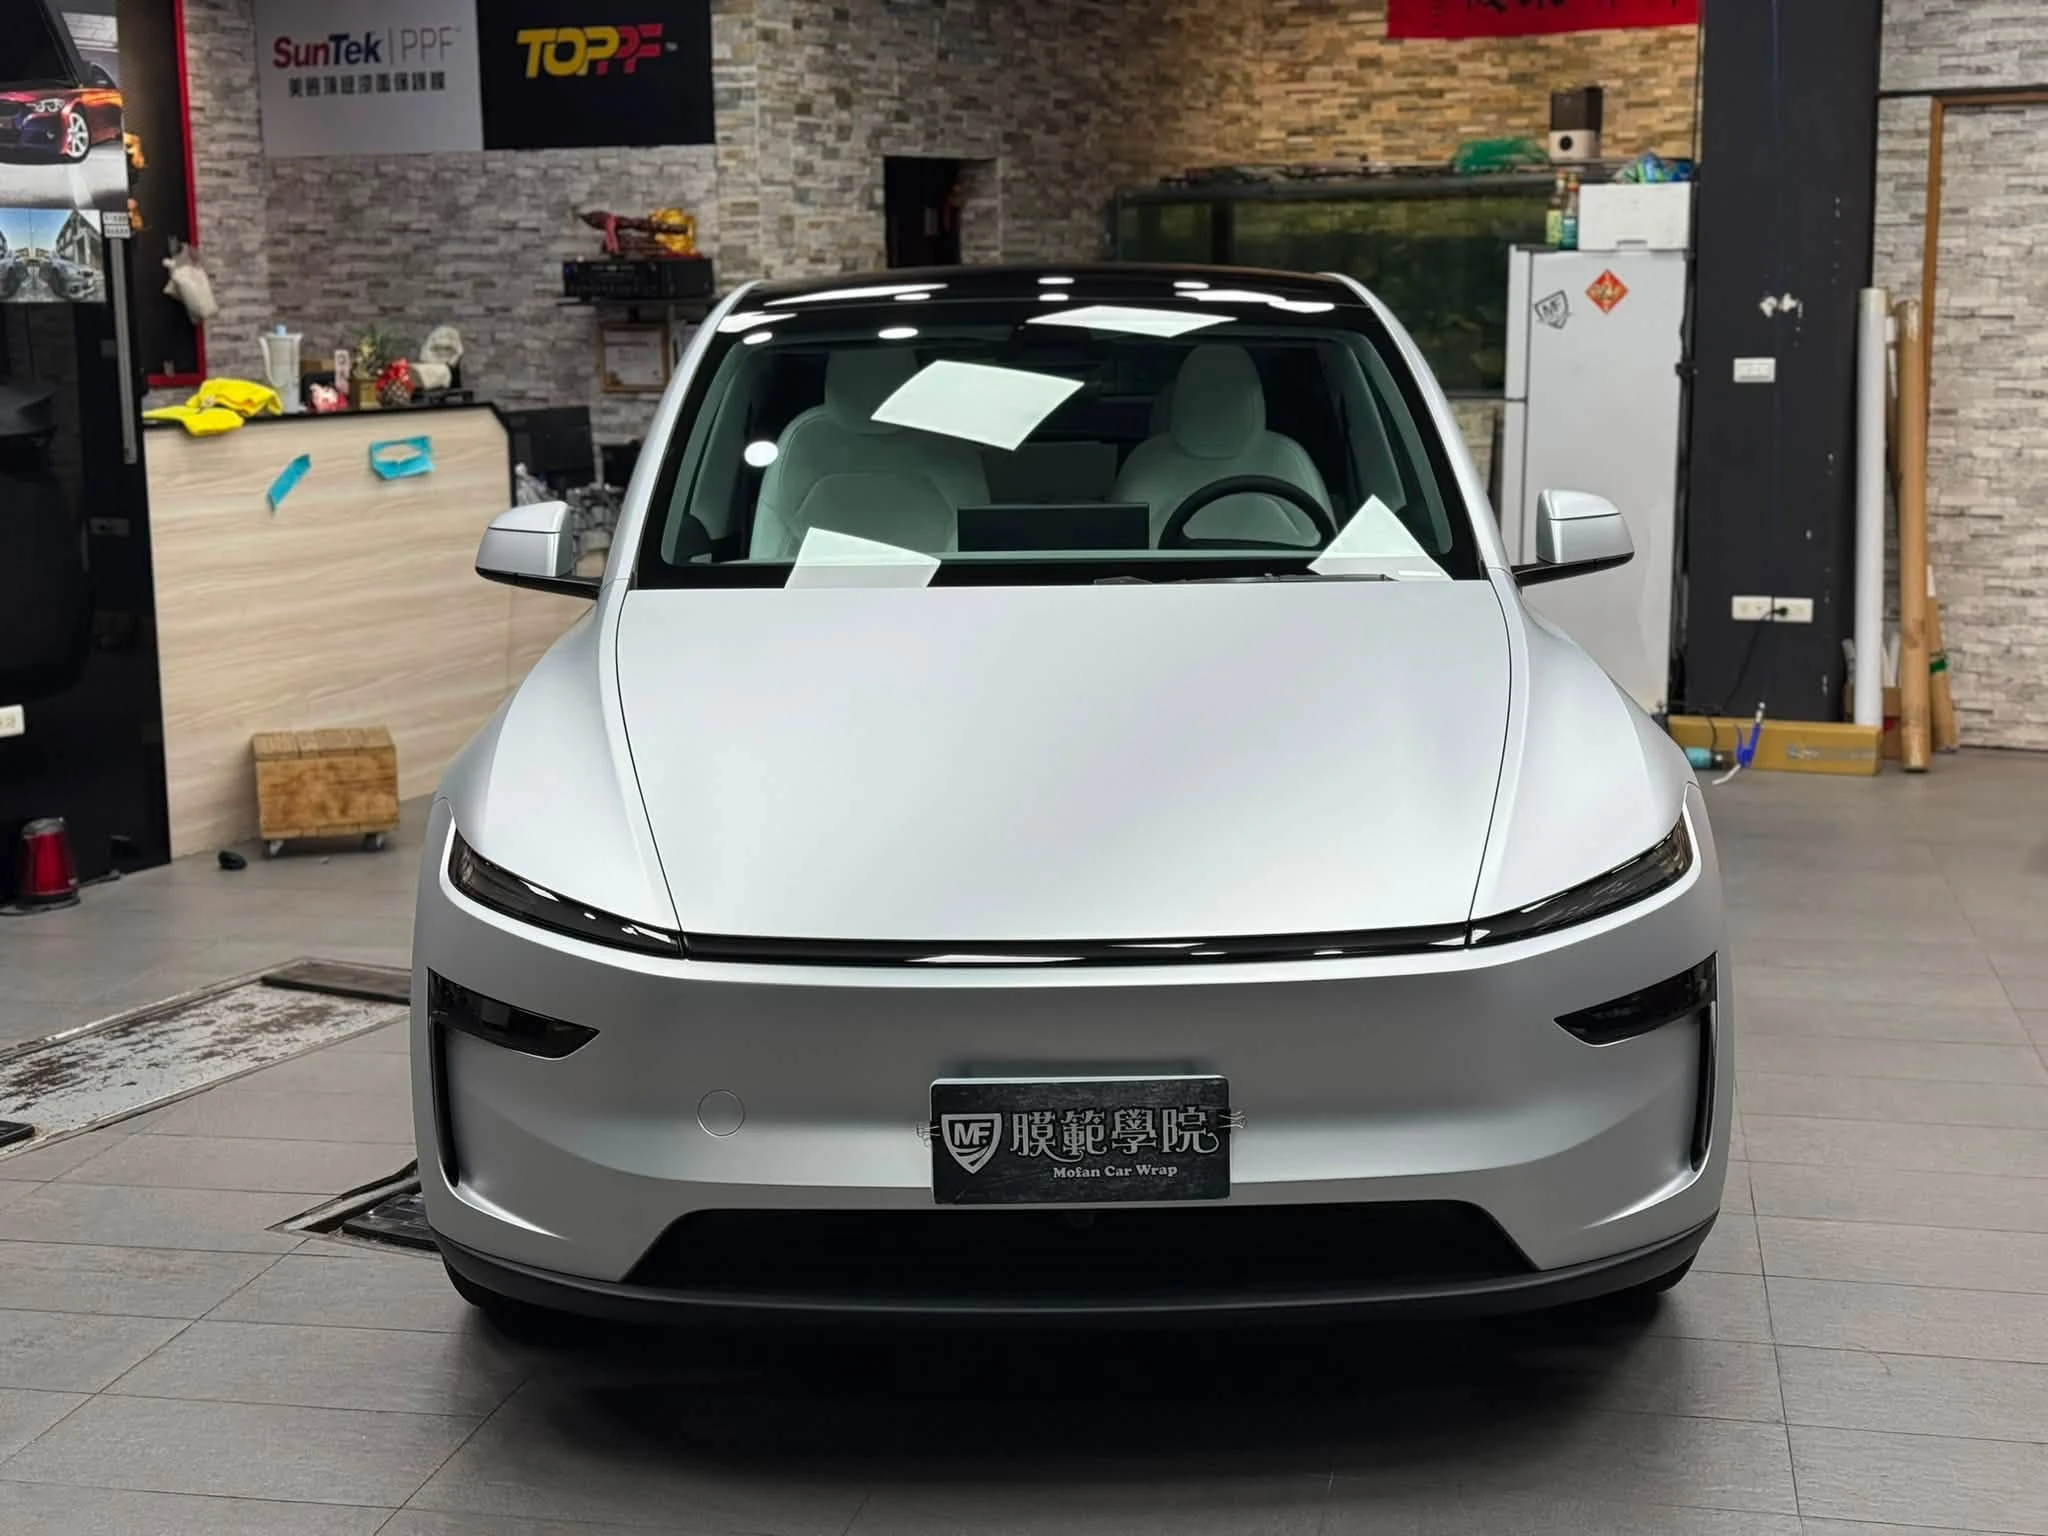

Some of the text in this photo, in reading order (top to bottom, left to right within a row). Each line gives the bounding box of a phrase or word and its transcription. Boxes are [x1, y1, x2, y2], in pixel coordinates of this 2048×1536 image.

[272, 26, 455, 69] SunTek PPF
[1009, 1105, 1220, 1163] 膜範學院
[1052, 1163, 1179, 1179] Mofan Car Wrap
